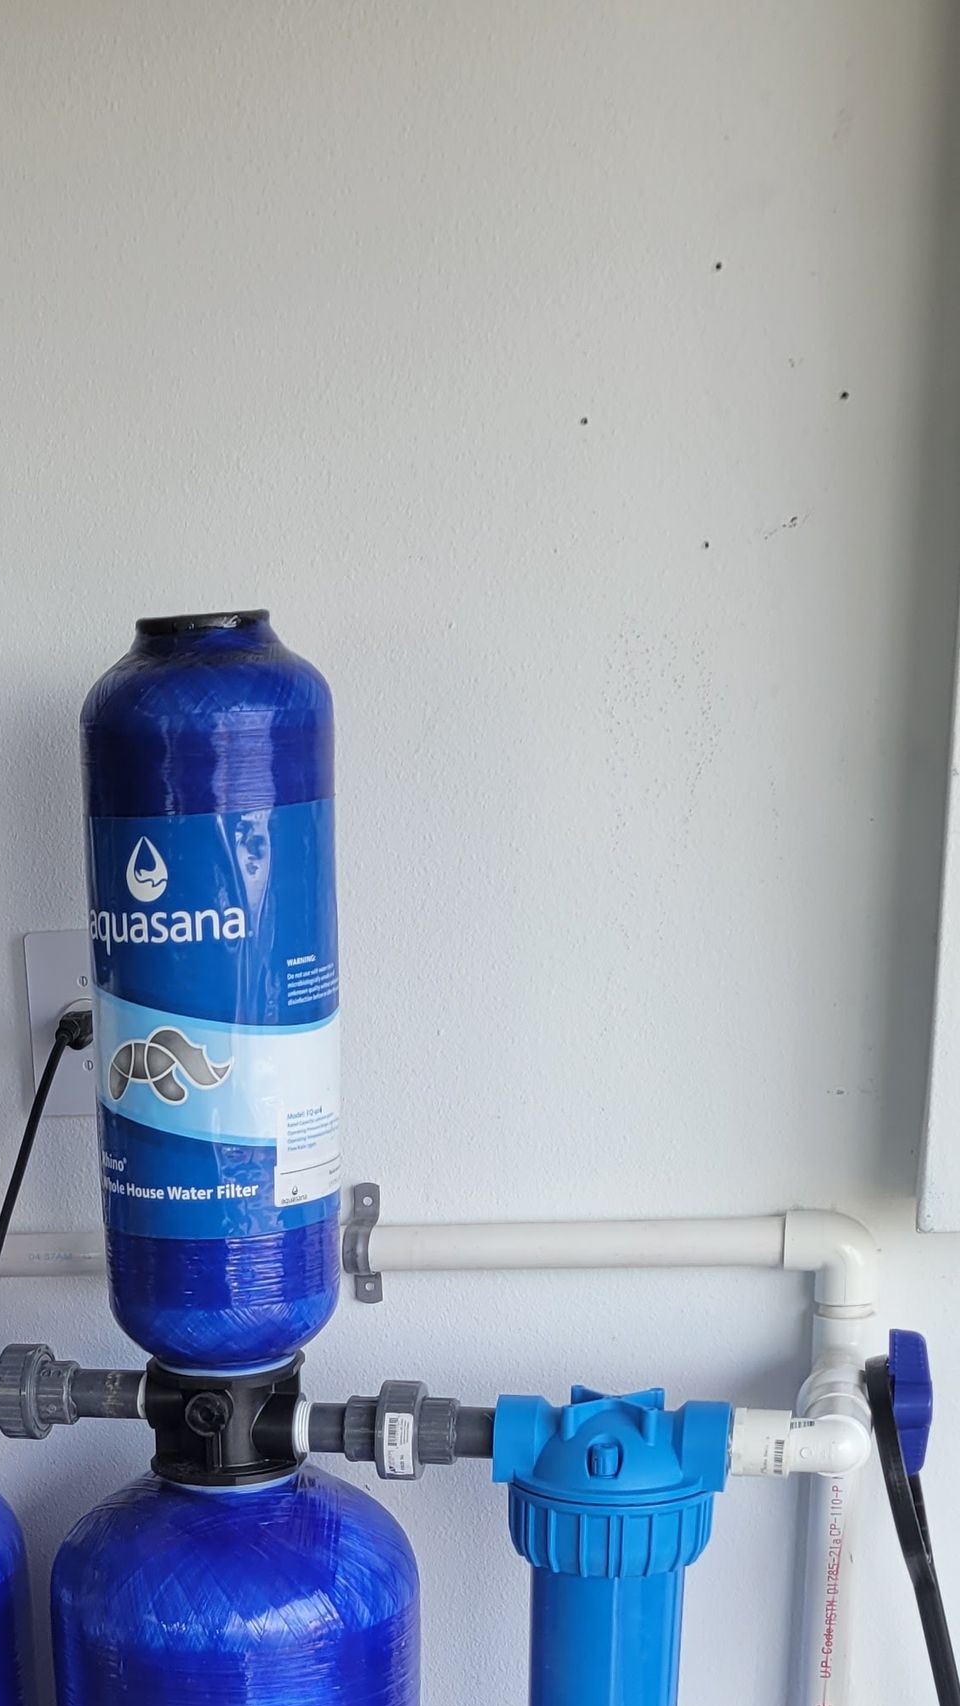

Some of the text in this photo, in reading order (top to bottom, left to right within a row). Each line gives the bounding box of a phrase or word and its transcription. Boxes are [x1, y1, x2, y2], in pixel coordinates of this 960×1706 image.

[89, 907, 246, 956] aquasana
[126, 1182, 165, 1200] House
[166, 1186, 213, 1201] Water
[217, 1183, 259, 1199] Filter
